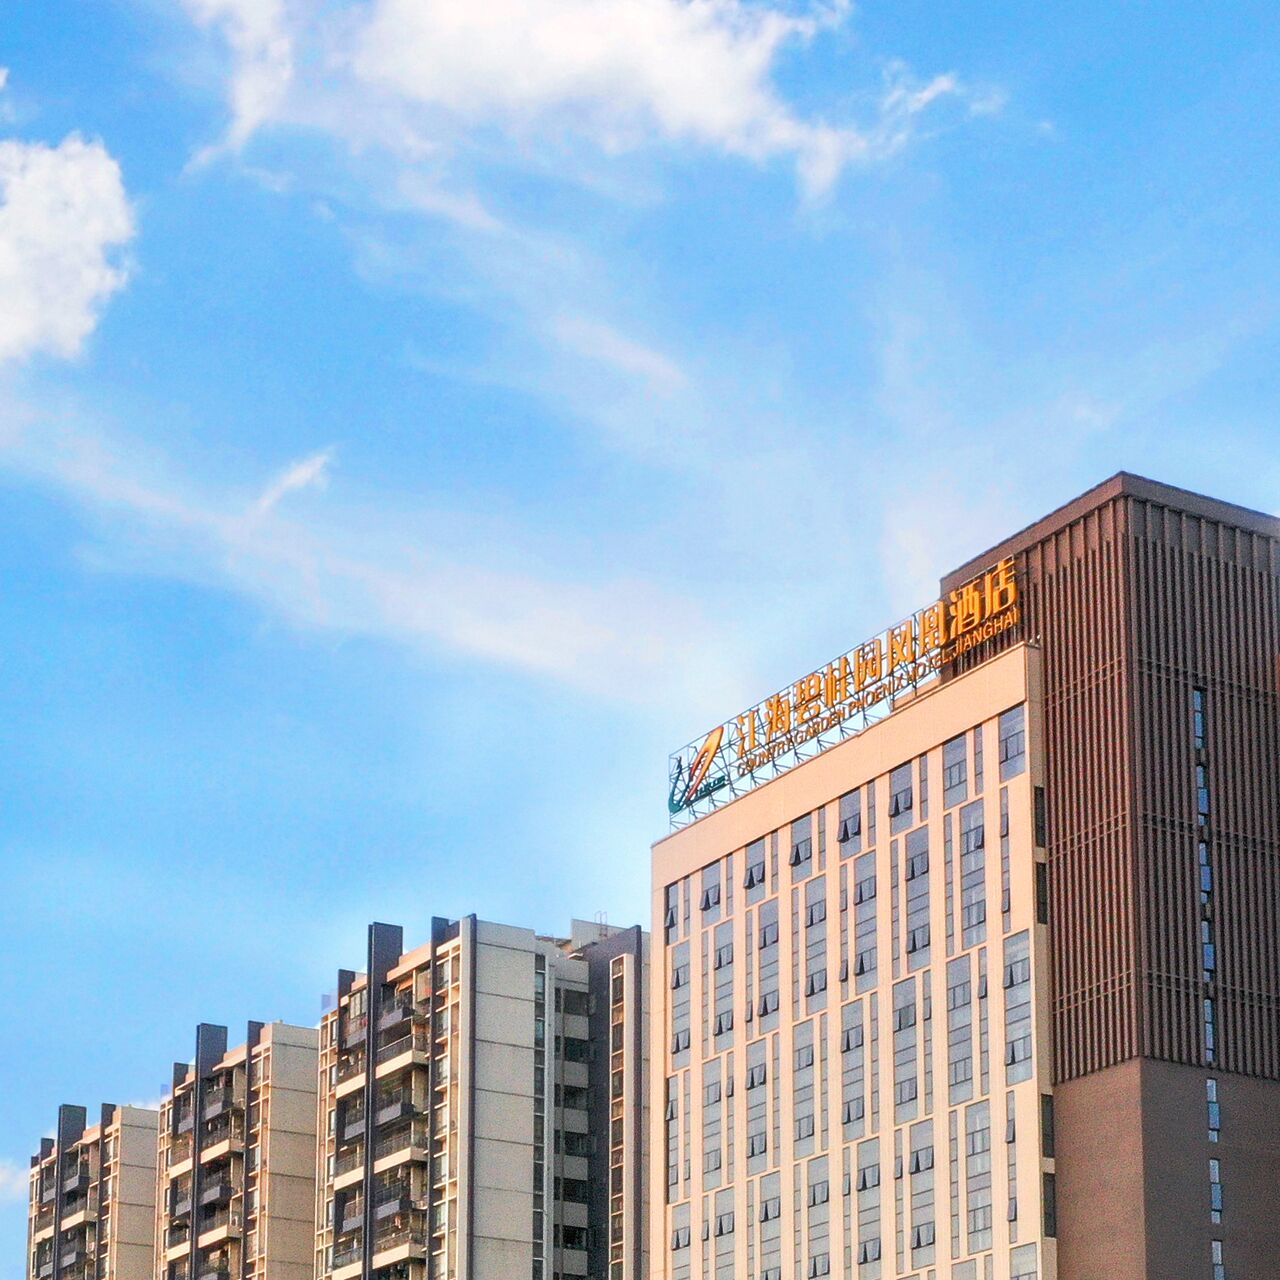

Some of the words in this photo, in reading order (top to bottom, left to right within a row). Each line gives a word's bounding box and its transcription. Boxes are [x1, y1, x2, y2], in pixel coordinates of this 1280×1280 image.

[736, 555, 1018, 758] 江海碧桂园凤凰酒店
